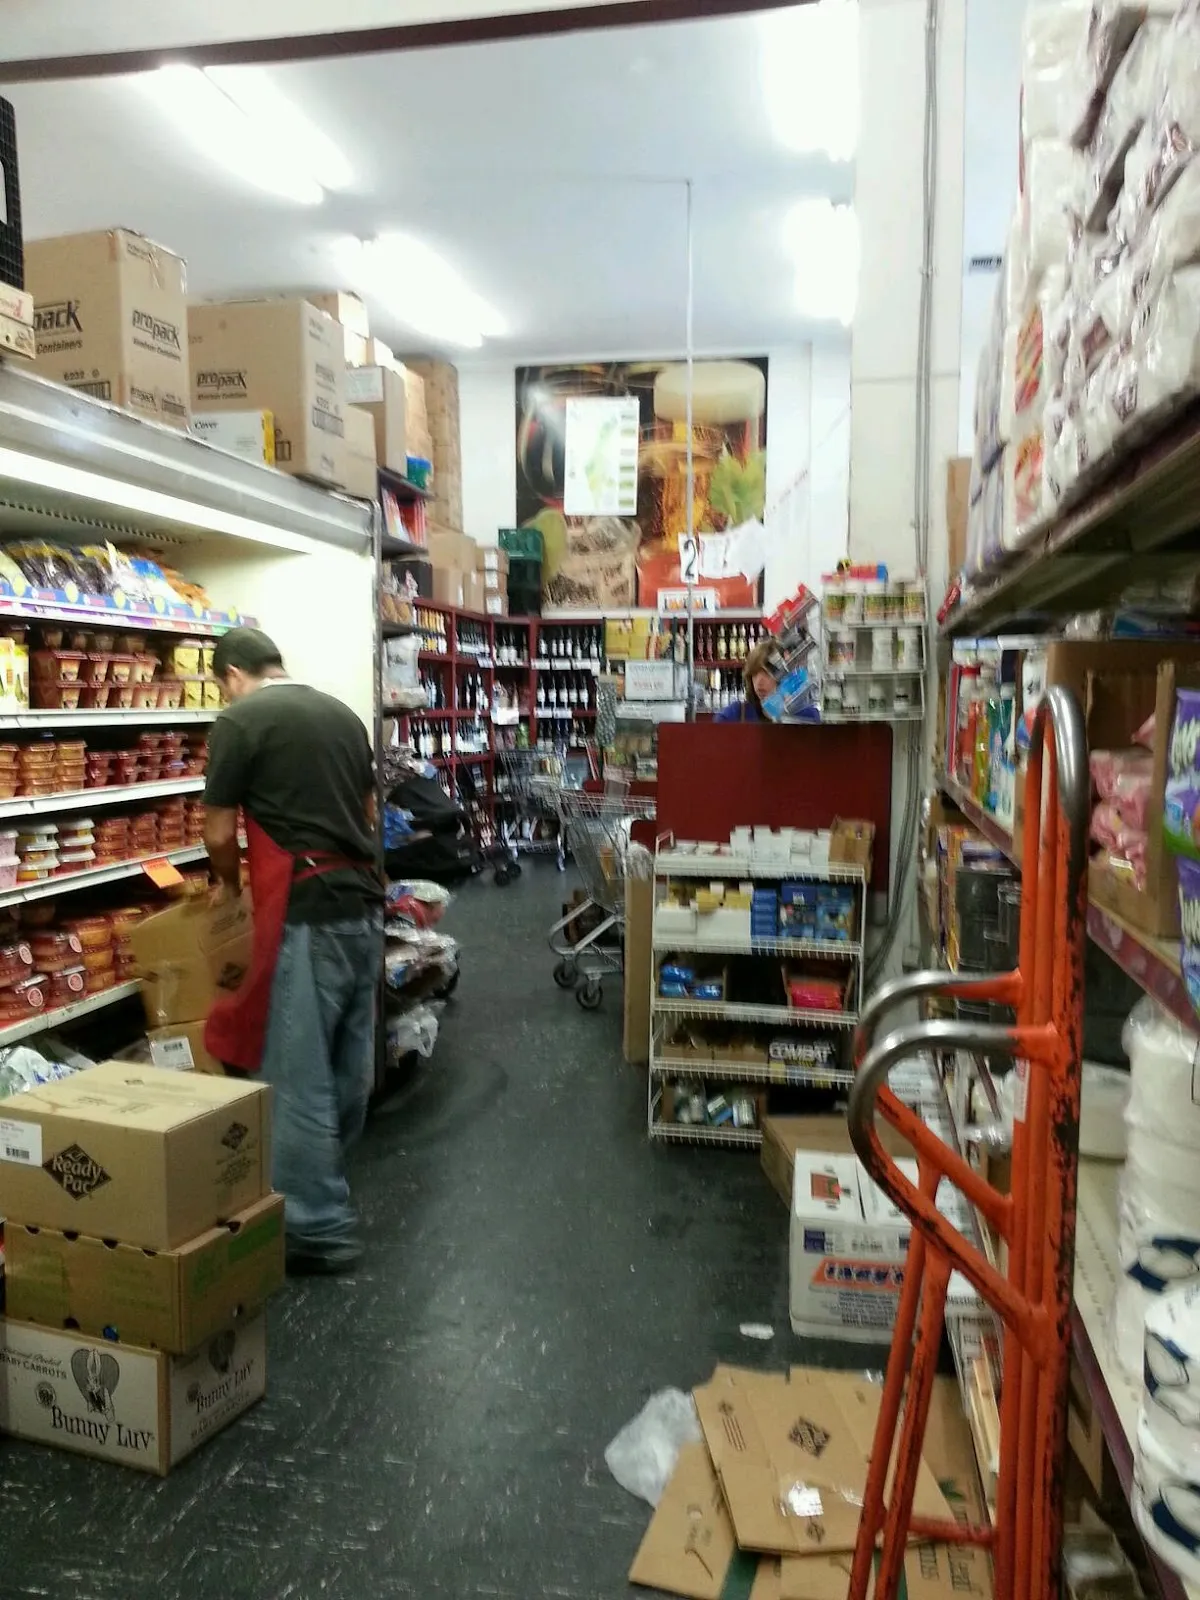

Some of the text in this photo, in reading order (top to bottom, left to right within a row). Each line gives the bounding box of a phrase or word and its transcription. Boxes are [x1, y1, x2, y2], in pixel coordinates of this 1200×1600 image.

[37, 339, 83, 355] Containers
[683, 538, 697, 579] 2
[769, 1041, 833, 1063] COMBAT
[52, 1153, 103, 1187] Ready
[63, 1173, 93, 1194] Pac
[52, 1404, 111, 1446] Bunny
